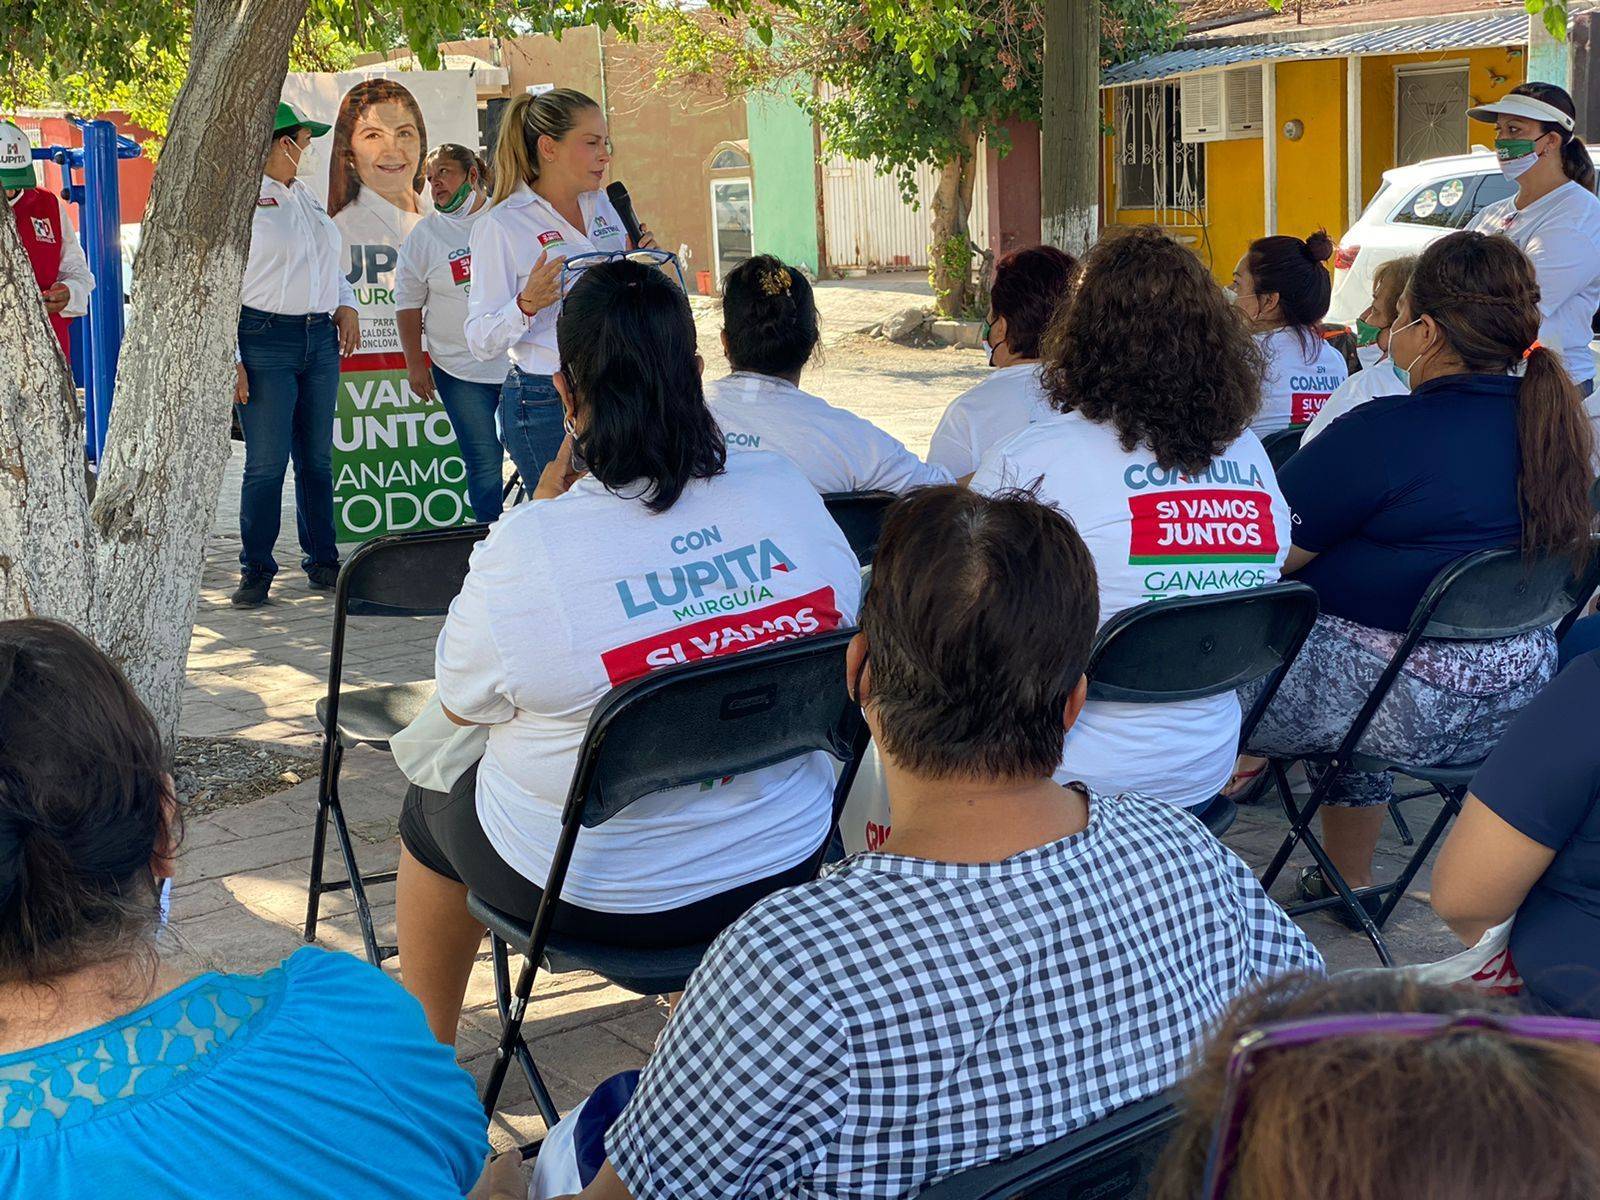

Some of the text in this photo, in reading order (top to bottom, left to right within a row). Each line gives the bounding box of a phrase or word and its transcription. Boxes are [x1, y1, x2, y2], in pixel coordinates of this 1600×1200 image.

[1, 155, 26, 164] UPITA
[361, 329, 398, 338] CALDESA
[373, 319, 395, 327] PARA
[361, 339, 399, 349] ONCLOVA
[333, 411, 457, 452] UNTO
[725, 432, 761, 448] CON
[333, 456, 467, 492] ANAMO
[1156, 499, 1260, 519] SI VAMOS
[671, 525, 723, 555] CON
[1157, 522, 1262, 546] JUNTOS
[615, 538, 798, 620] LUPITA
[1144, 569, 1266, 591] GANAMOS
[672, 585, 774, 621] MURGUÍA
[646, 642, 688, 667] SI
[689, 607, 820, 655] VAMOS
